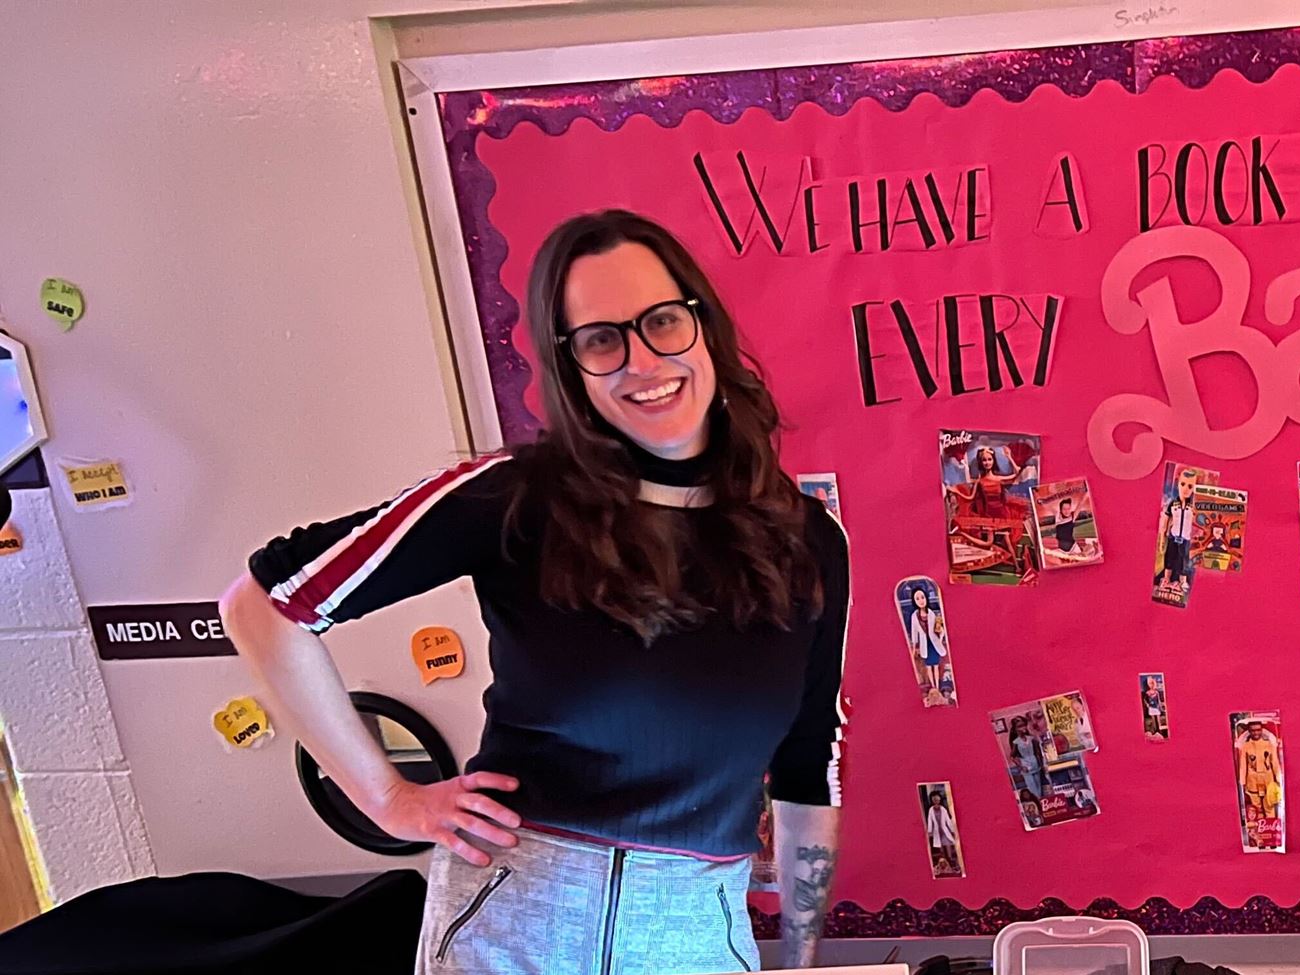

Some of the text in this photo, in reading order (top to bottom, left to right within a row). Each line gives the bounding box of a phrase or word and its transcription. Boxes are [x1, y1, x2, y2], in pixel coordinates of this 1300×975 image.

[848, 166, 990, 252] HAVE
[1036, 157, 1084, 234] A
[1138, 134, 1287, 232] BOOK
[852, 295, 1060, 408] EVERY
[942, 430, 973, 449] Barbie
[74, 490, 101, 502] WHO
[101, 489, 107, 498] I
[1158, 591, 1181, 602] HERO
[106, 619, 227, 643] MEDIA CE
[1041, 798, 1066, 812] Barbie
